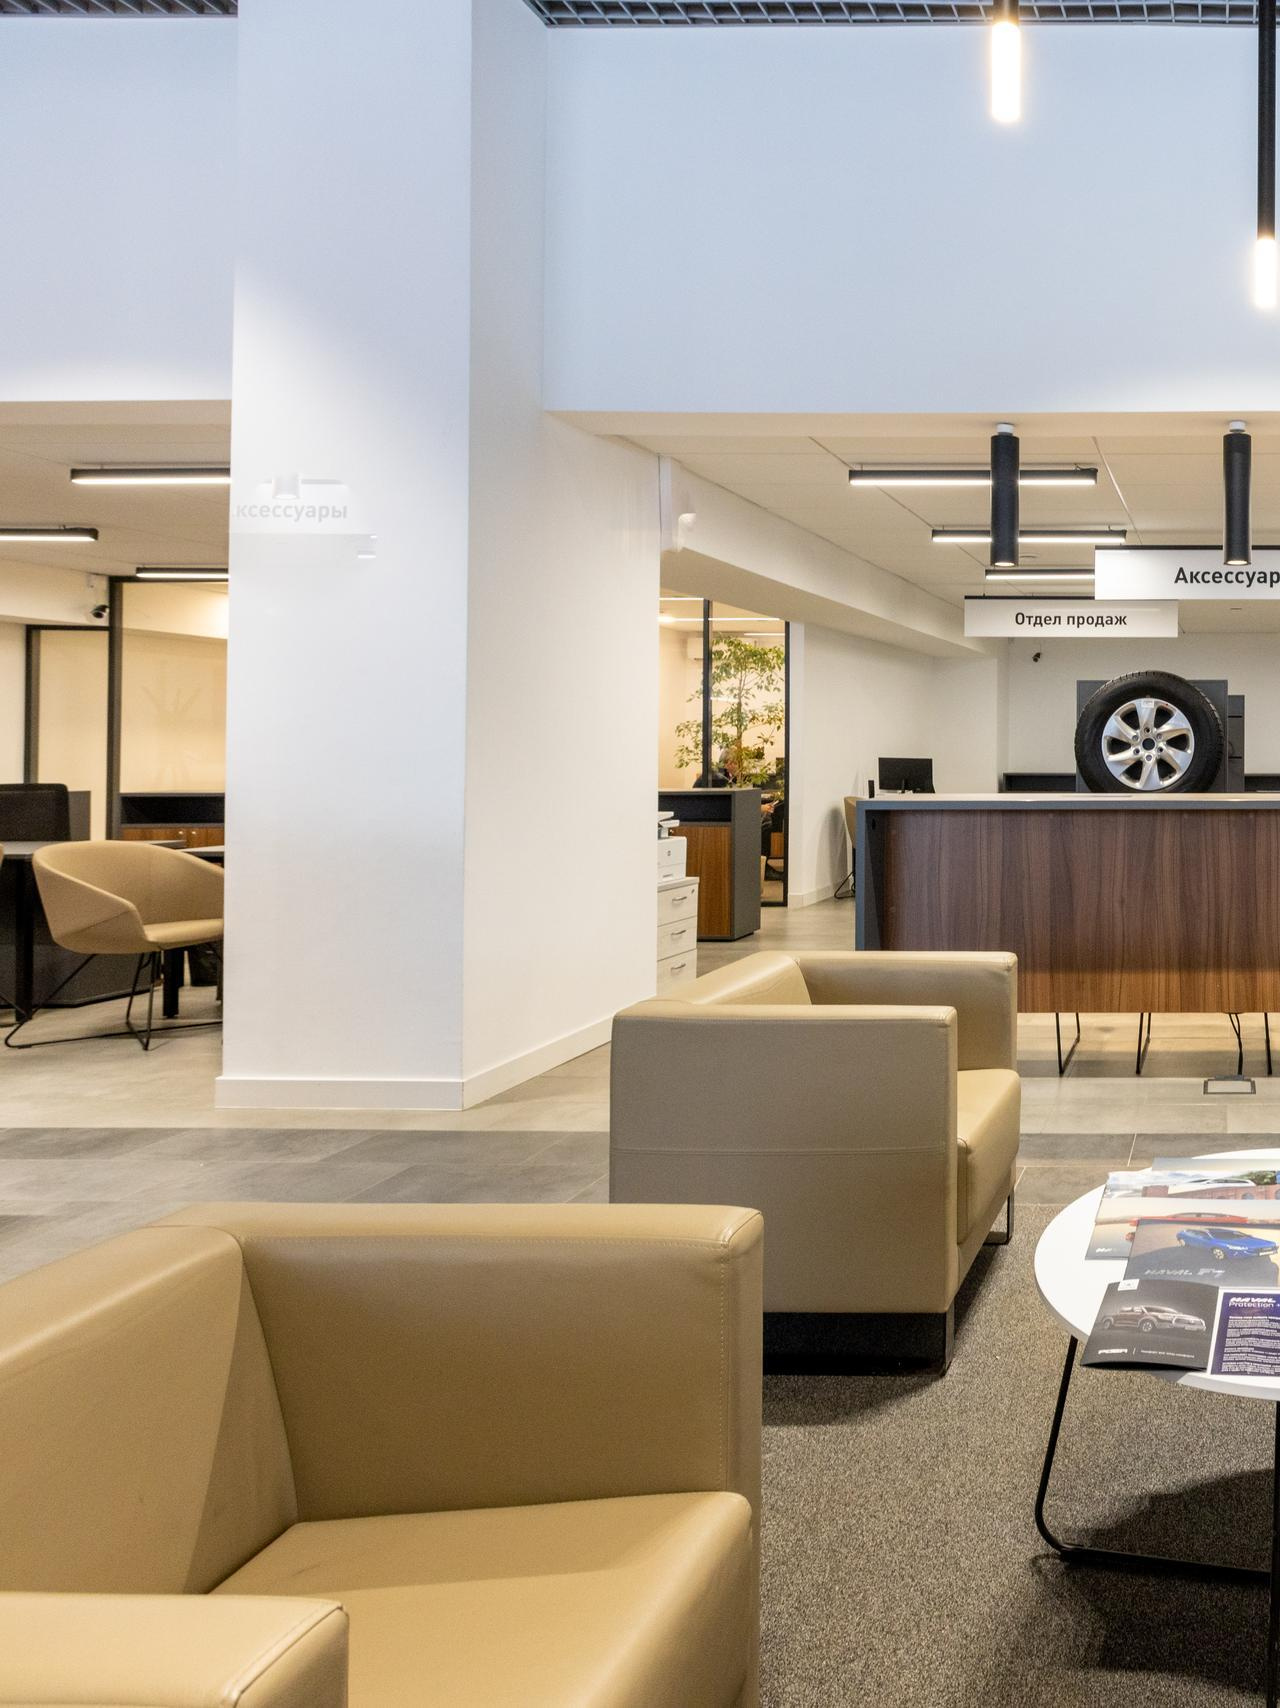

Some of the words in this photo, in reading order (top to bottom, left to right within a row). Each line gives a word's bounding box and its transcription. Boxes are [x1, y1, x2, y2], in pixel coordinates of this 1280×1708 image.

[232, 504, 348, 523] ксессуары
[1015, 612, 1062, 627] Отдел
[1066, 615, 1127, 628] продаж
